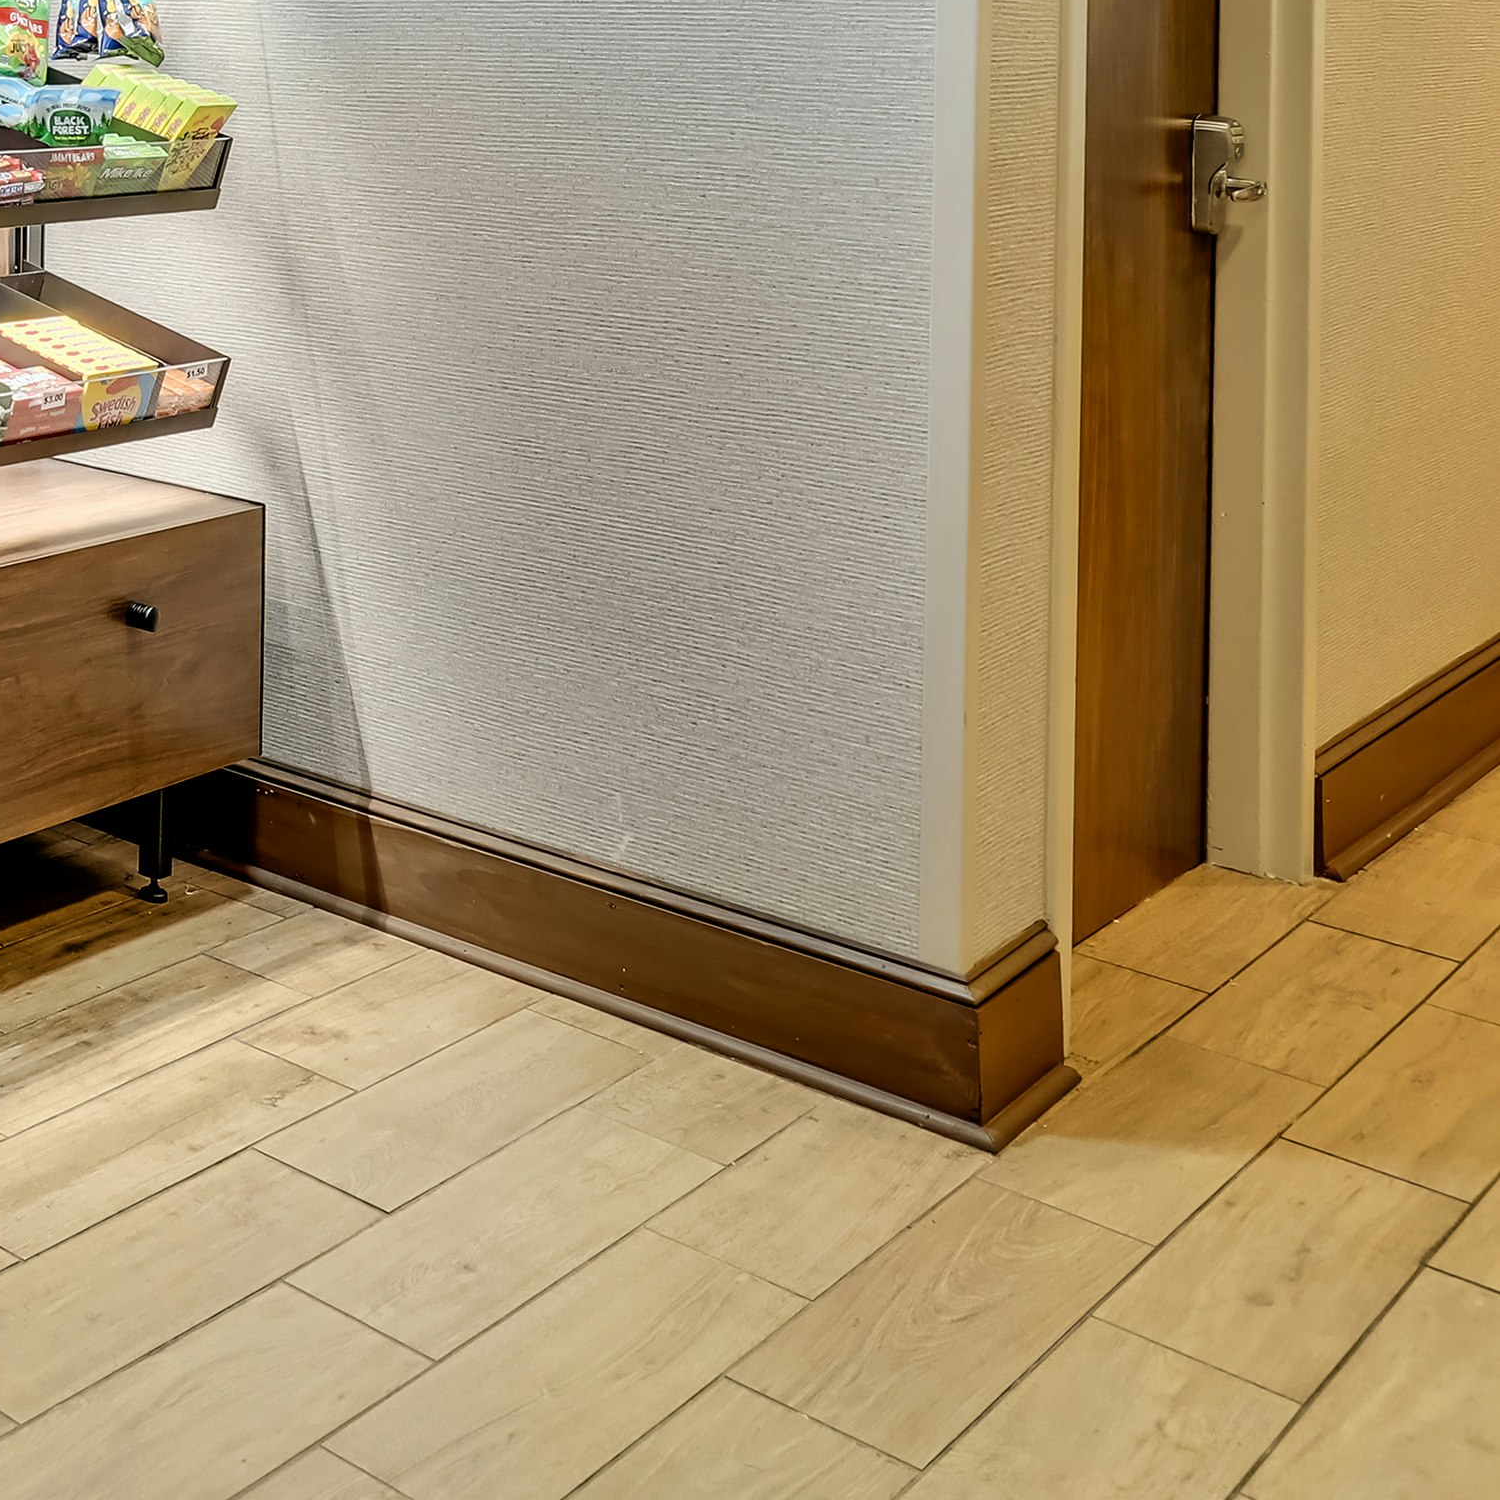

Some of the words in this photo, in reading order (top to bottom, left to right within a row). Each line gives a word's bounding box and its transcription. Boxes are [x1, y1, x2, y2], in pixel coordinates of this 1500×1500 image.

[53, 115, 85, 126] BLACK
[52, 124, 90, 136] FOREST
[71, 152, 95, 162] BEARS
[101, 167, 131, 180] Mike
[132, 167, 153, 178] Ike
[186, 367, 206, 379] $1.50
[43, 393, 64, 406] $3.00
[89, 394, 137, 422] Swedish
[98, 411, 122, 429] Fish
